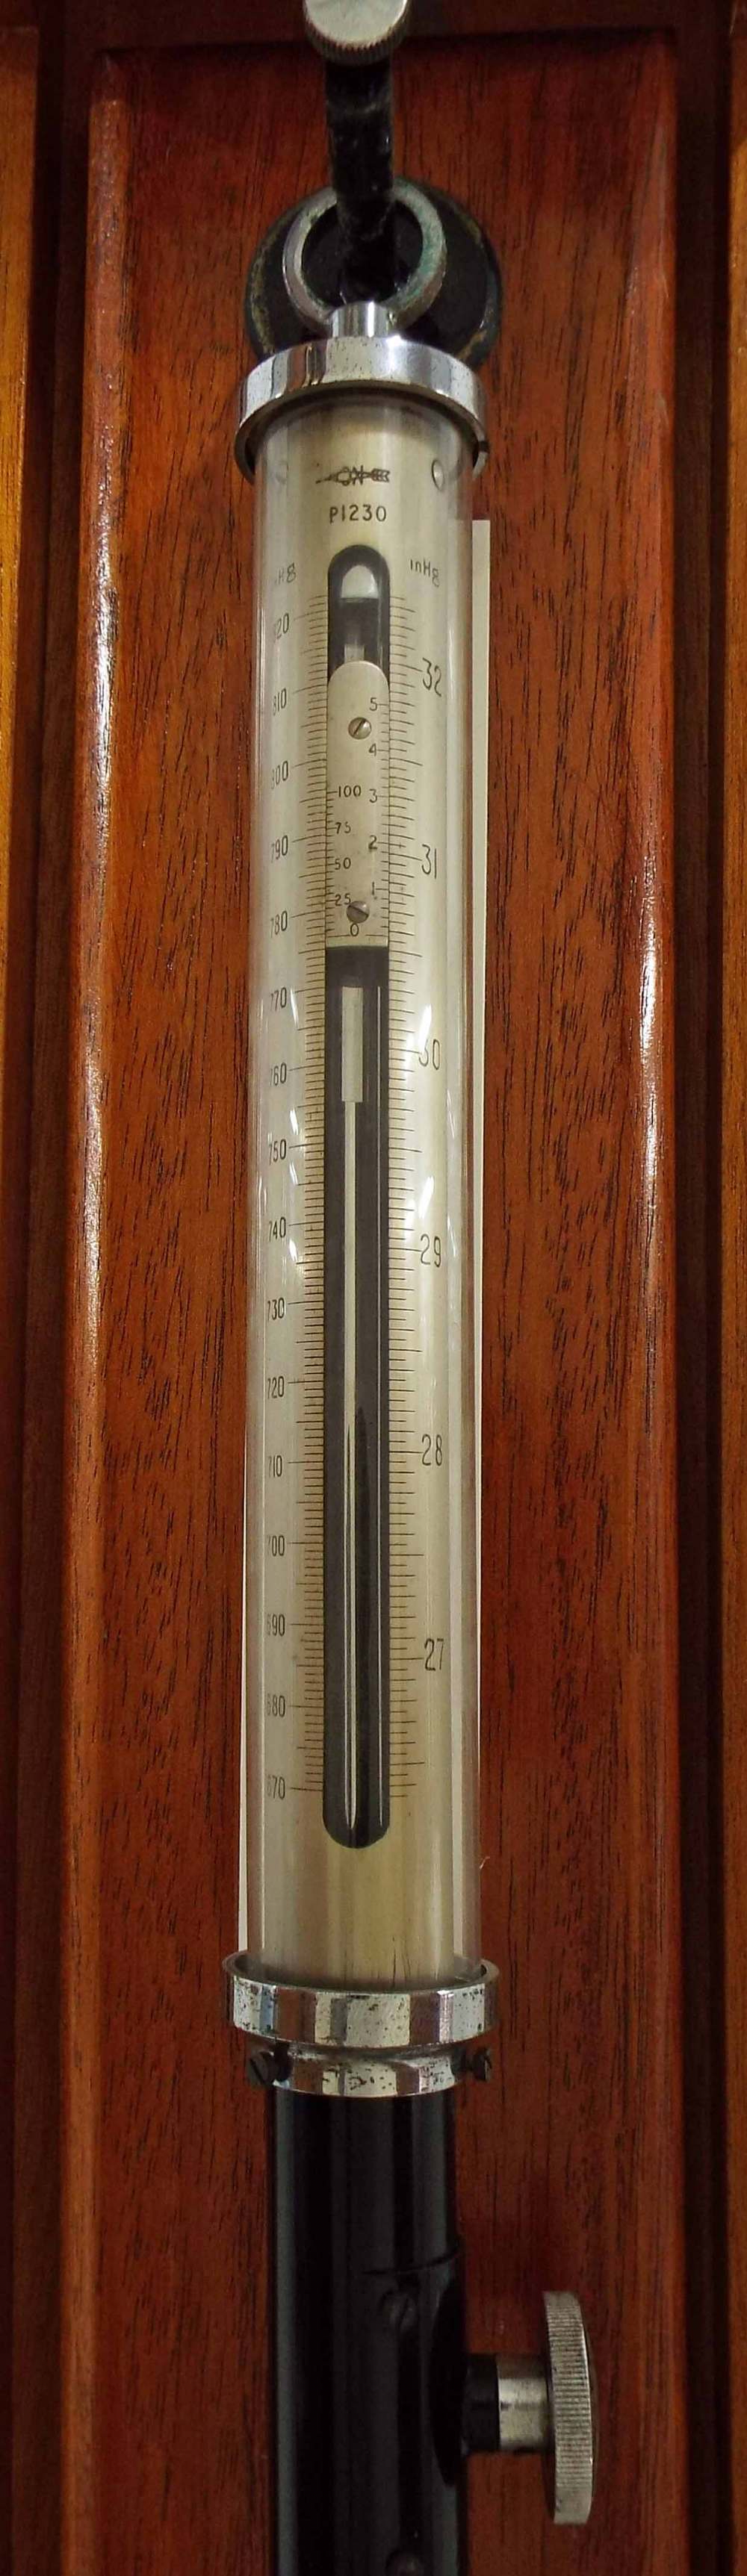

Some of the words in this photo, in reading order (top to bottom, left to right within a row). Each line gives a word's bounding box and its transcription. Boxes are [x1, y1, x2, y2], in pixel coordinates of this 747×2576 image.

[329, 504, 387, 524] P1230
[274, 613, 289, 639] 20
[422, 657, 442, 697] 32
[369, 697, 379, 712] 5
[368, 742, 378, 757] 4
[337, 785, 362, 797] 100
[369, 788, 379, 803] 3
[335, 822, 352, 834] 75
[270, 835, 288, 863] 790
[368, 835, 379, 850] 2
[334, 858, 352, 871] 50
[422, 844, 438, 879] 31
[335, 892, 351, 906] 25
[270, 910, 288, 938] 780
[350, 922, 359, 937] 0
[269, 1139, 287, 1166] 750
[268, 1216, 286, 1242] 740
[420, 1233, 442, 1267] 29
[267, 1297, 285, 1322] 730
[267, 1375, 285, 1399] 720
[421, 1433, 444, 1466] 28
[424, 1637, 445, 1672] 27
